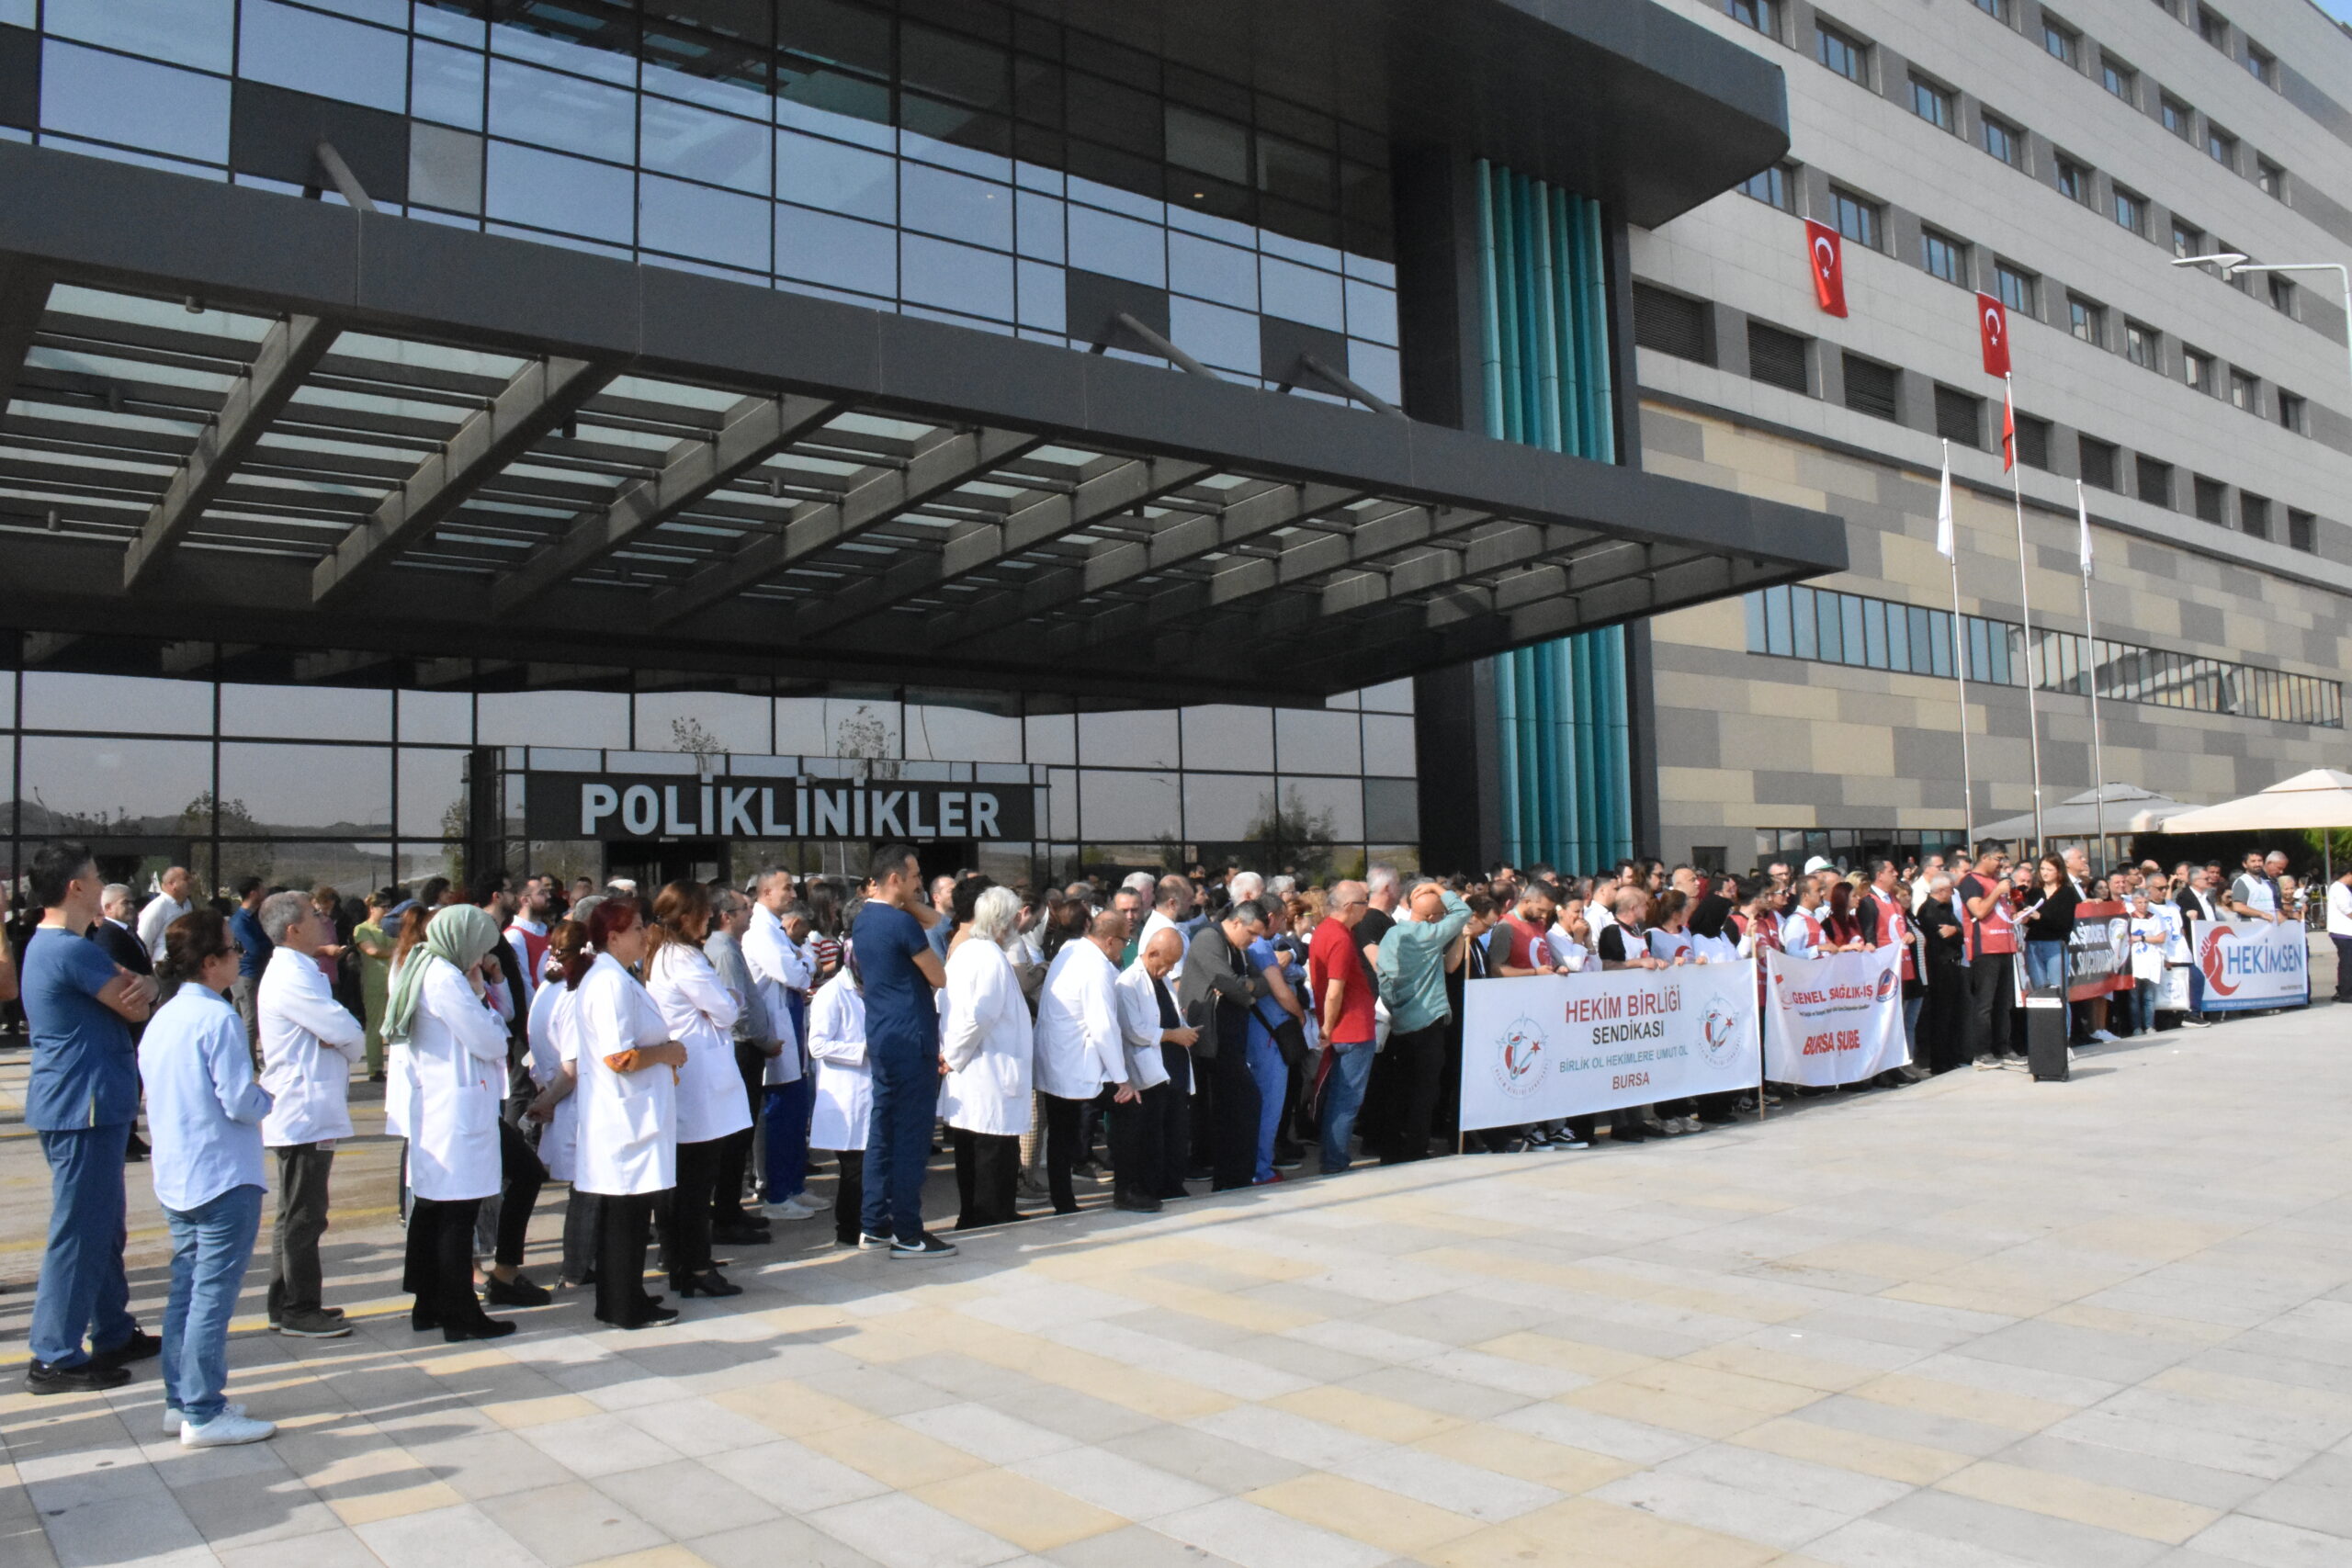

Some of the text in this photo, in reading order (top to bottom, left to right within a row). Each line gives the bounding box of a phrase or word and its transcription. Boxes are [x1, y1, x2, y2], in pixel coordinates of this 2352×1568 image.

[581, 773, 1001, 838] POLİKLİNİKLER
[2227, 938, 2301, 975] HEKİMSEN
[1566, 985, 1681, 1023] HEKİM BİRLİĞİ
[1792, 982, 1873, 1005] GENEL SAĞLIK-İŞ
[1592, 1020, 1664, 1044] SENDİKASI
[1803, 1029, 1860, 1057] BURSA ŞUBE
[1559, 1045, 1689, 1073] BİRLİK OL HEKİMLERE UMUT OL
[1612, 1072, 1650, 1090] BURSA
